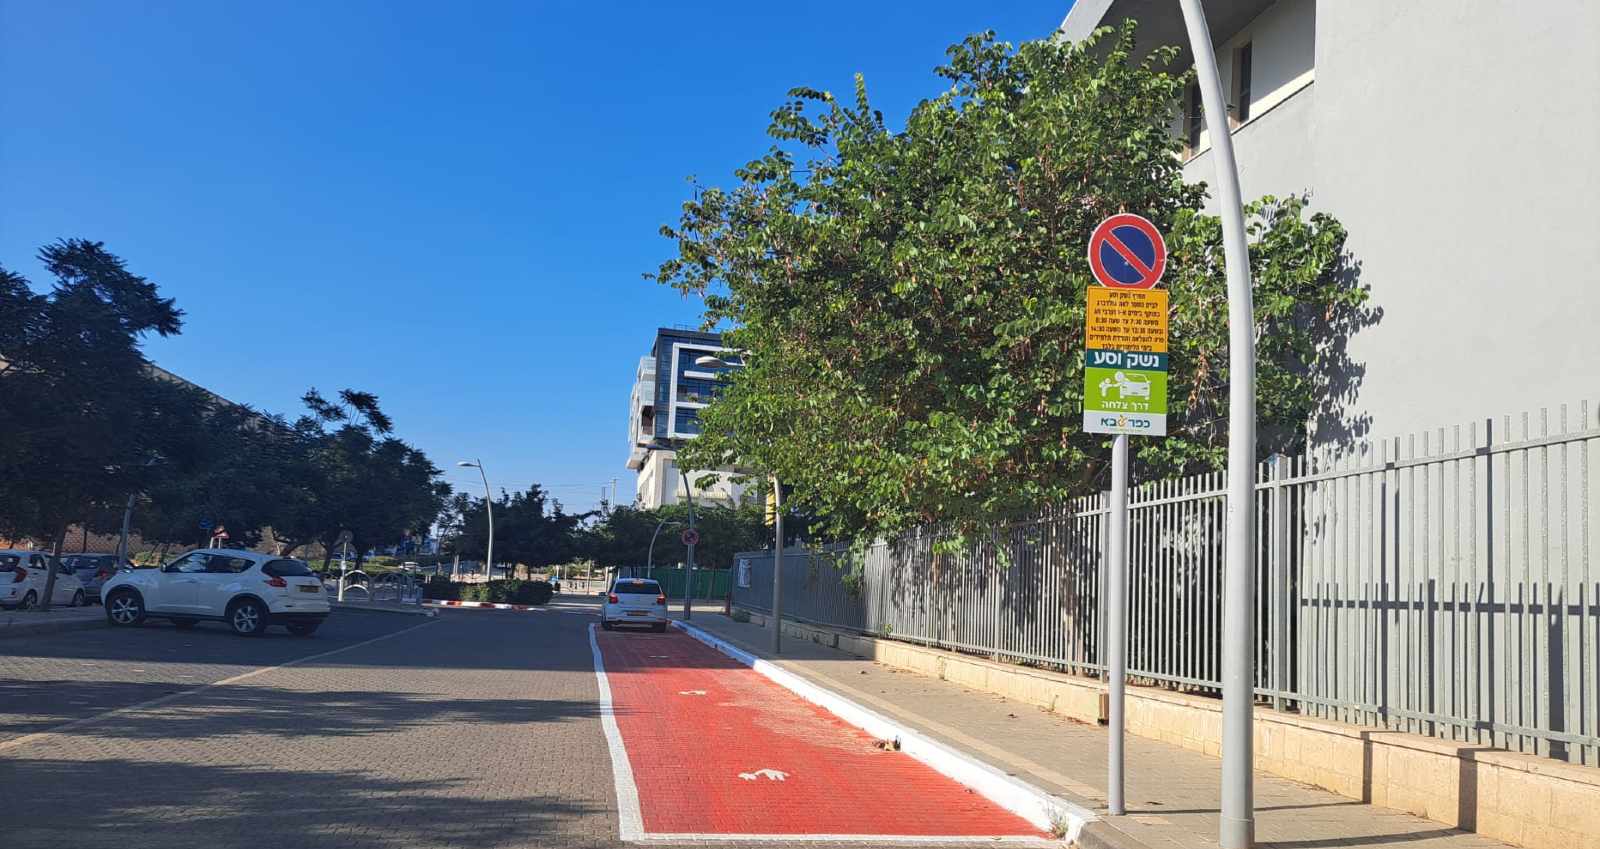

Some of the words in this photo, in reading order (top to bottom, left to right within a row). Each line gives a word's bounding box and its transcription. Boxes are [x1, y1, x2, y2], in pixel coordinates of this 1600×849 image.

[1094, 351, 1122, 366] וסע
[1126, 353, 1160, 369] נשק
[1101, 400, 1128, 409] צלחה
[1131, 402, 1149, 411] דרך
[1128, 418, 1151, 428] כפר
